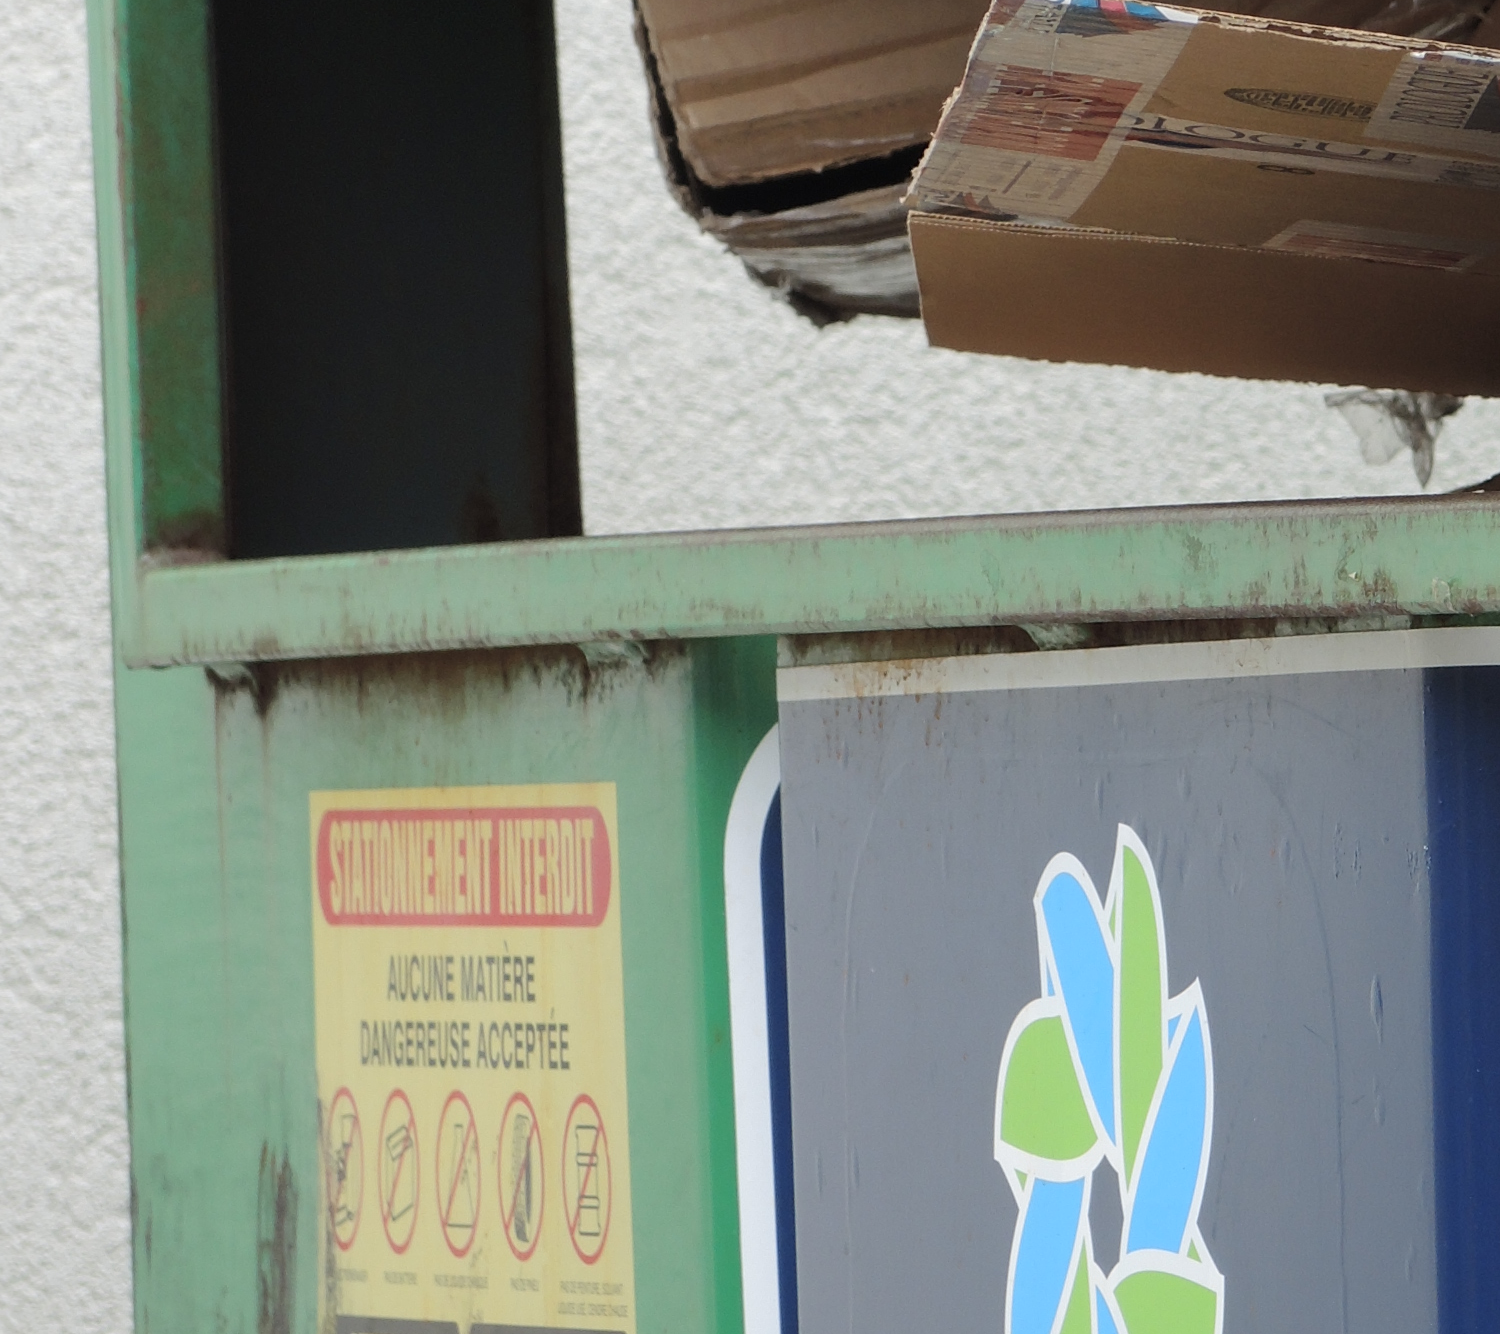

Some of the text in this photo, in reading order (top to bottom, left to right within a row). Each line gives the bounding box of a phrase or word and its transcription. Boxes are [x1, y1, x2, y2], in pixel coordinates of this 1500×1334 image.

[330, 818, 595, 916] STATIONNEMENT INTERDIT
[387, 940, 536, 1003] AUCUNE MATIÈRE
[360, 1008, 571, 1070] DANGEREUSE ACCEPTÉE
